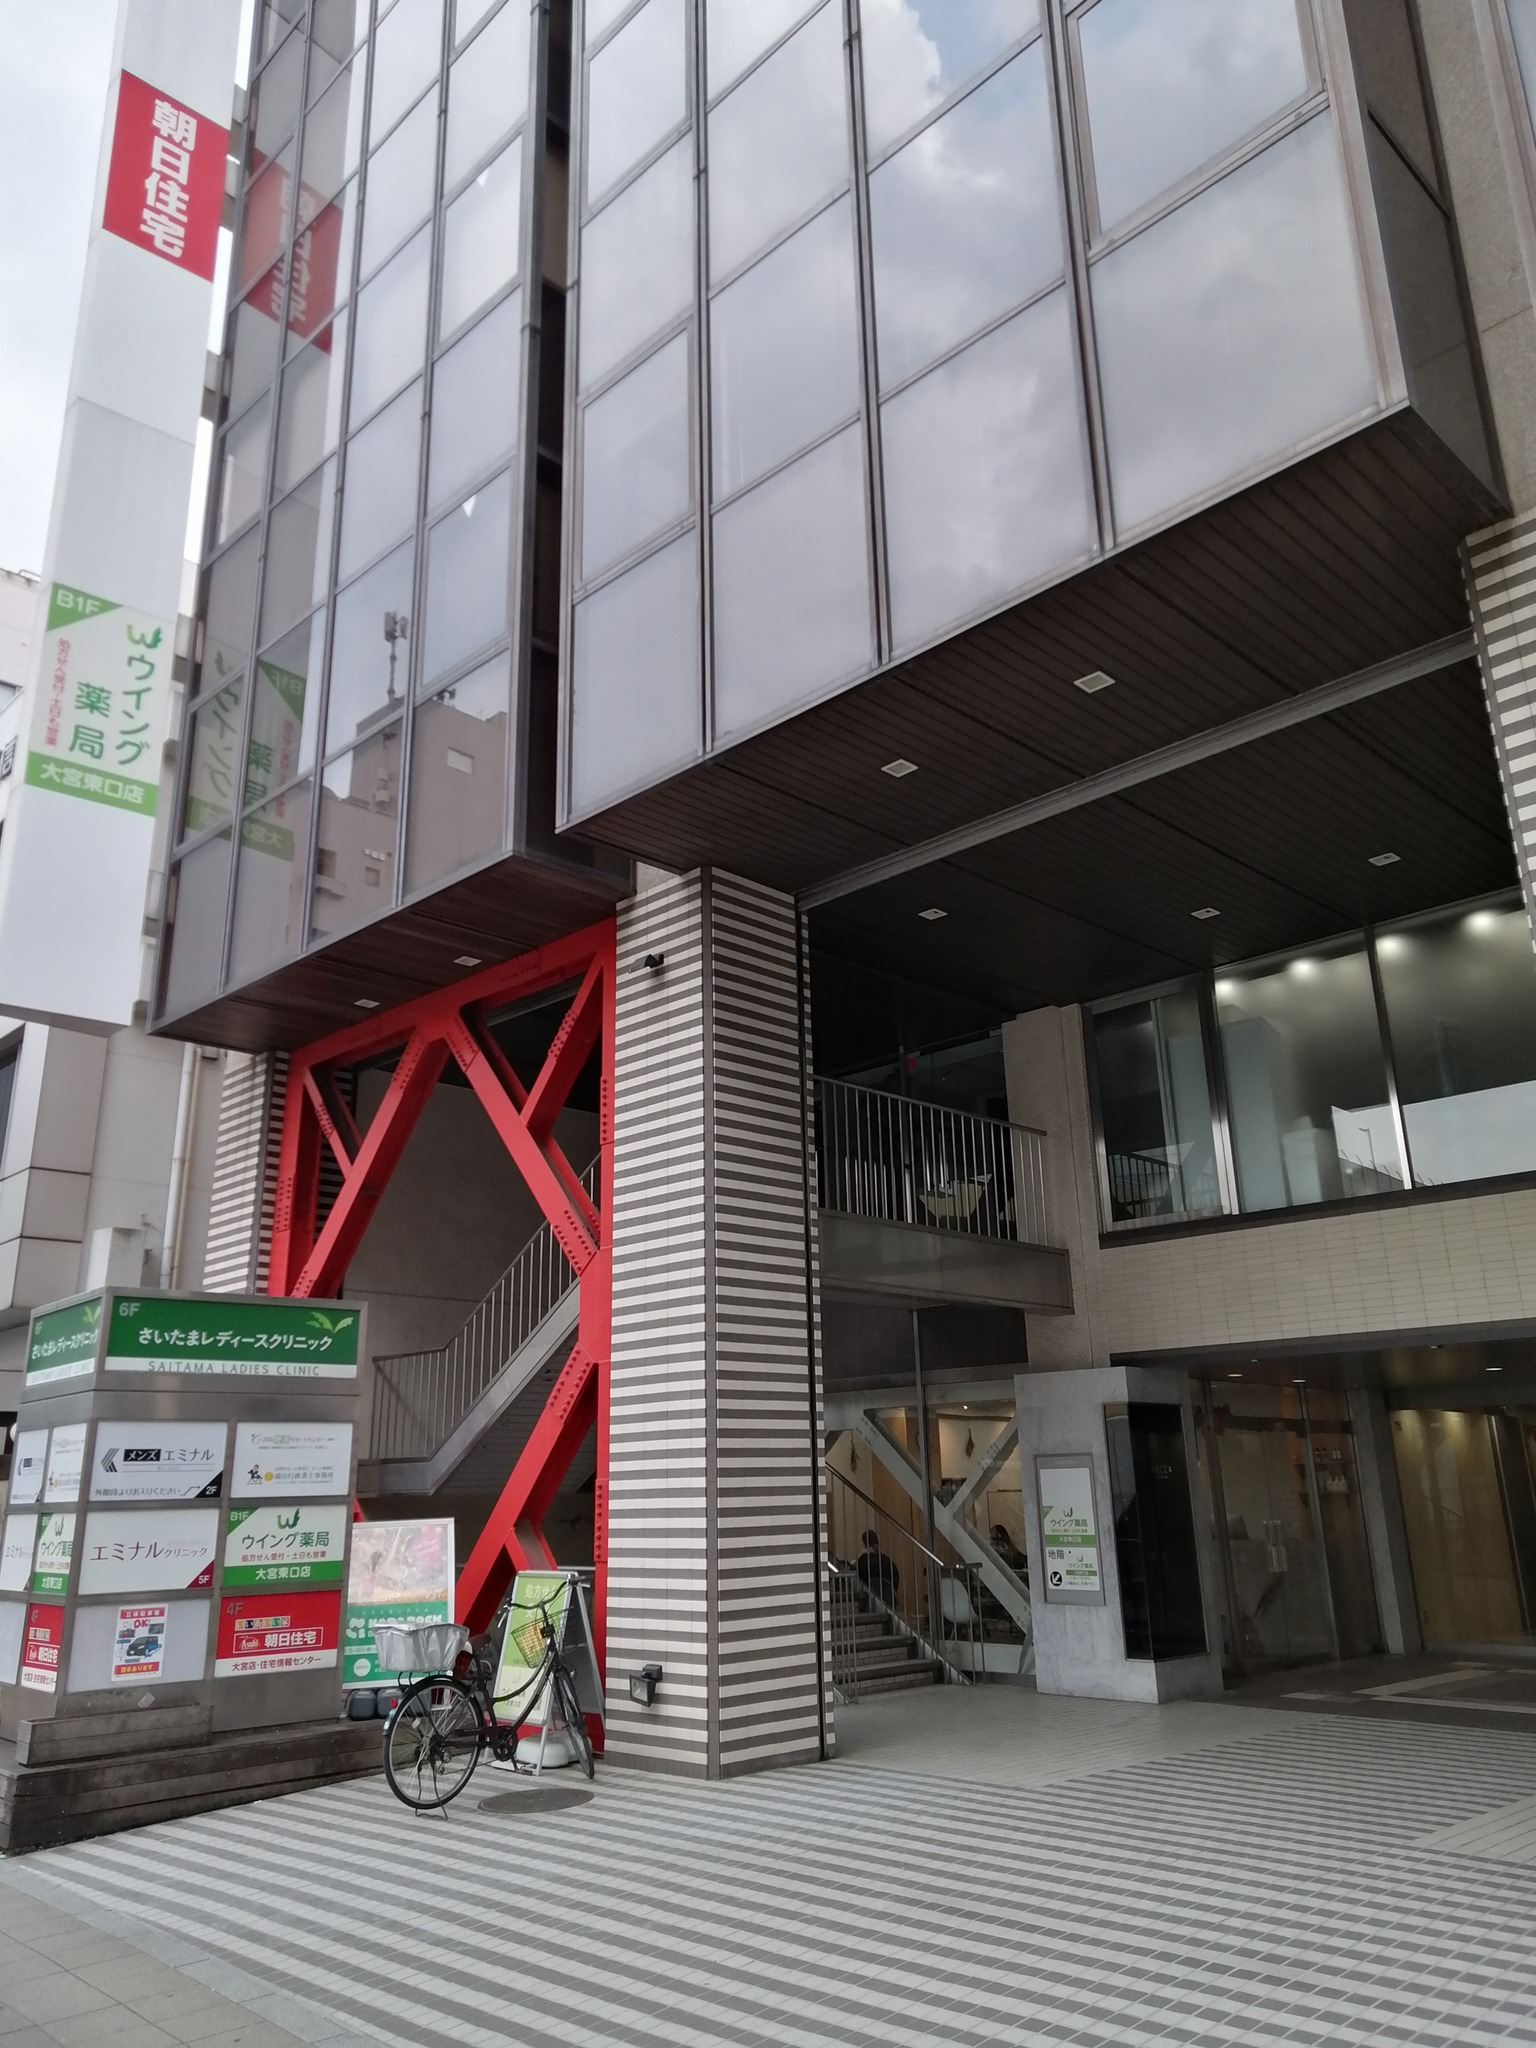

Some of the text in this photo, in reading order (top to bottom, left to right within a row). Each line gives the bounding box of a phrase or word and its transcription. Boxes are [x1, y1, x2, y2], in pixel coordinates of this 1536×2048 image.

[140, 98, 197, 258] 朝日住宅
[56, 588, 102, 616] B1F
[115, 653, 155, 765] ウイング
[68, 681, 112, 760] 薬局
[40, 761, 145, 804] 大宮東口店
[119, 1302, 141, 1317] 6F
[138, 1327, 333, 1351] さいたまレディースクリニック
[148, 1360, 320, 1377] SAITAMA LADIES CLINIC
[205, 1485, 217, 1495] 2F
[230, 1511, 250, 1521] B1F
[1050, 1519, 1088, 1528] ウイング薬局
[242, 1531, 330, 1550] ウイング薬局
[241, 1551, 326, 1563] 処方せん受付・土日も営業
[1048, 1550, 1065, 1560] 地階
[198, 1575, 210, 1584] 5F
[255, 1566, 312, 1580] 大宮東口店
[226, 1602, 244, 1615] 4F
[264, 1631, 317, 1648] 朝日住宅
[231, 1656, 321, 1672] 大宮店・住宅情報センター
